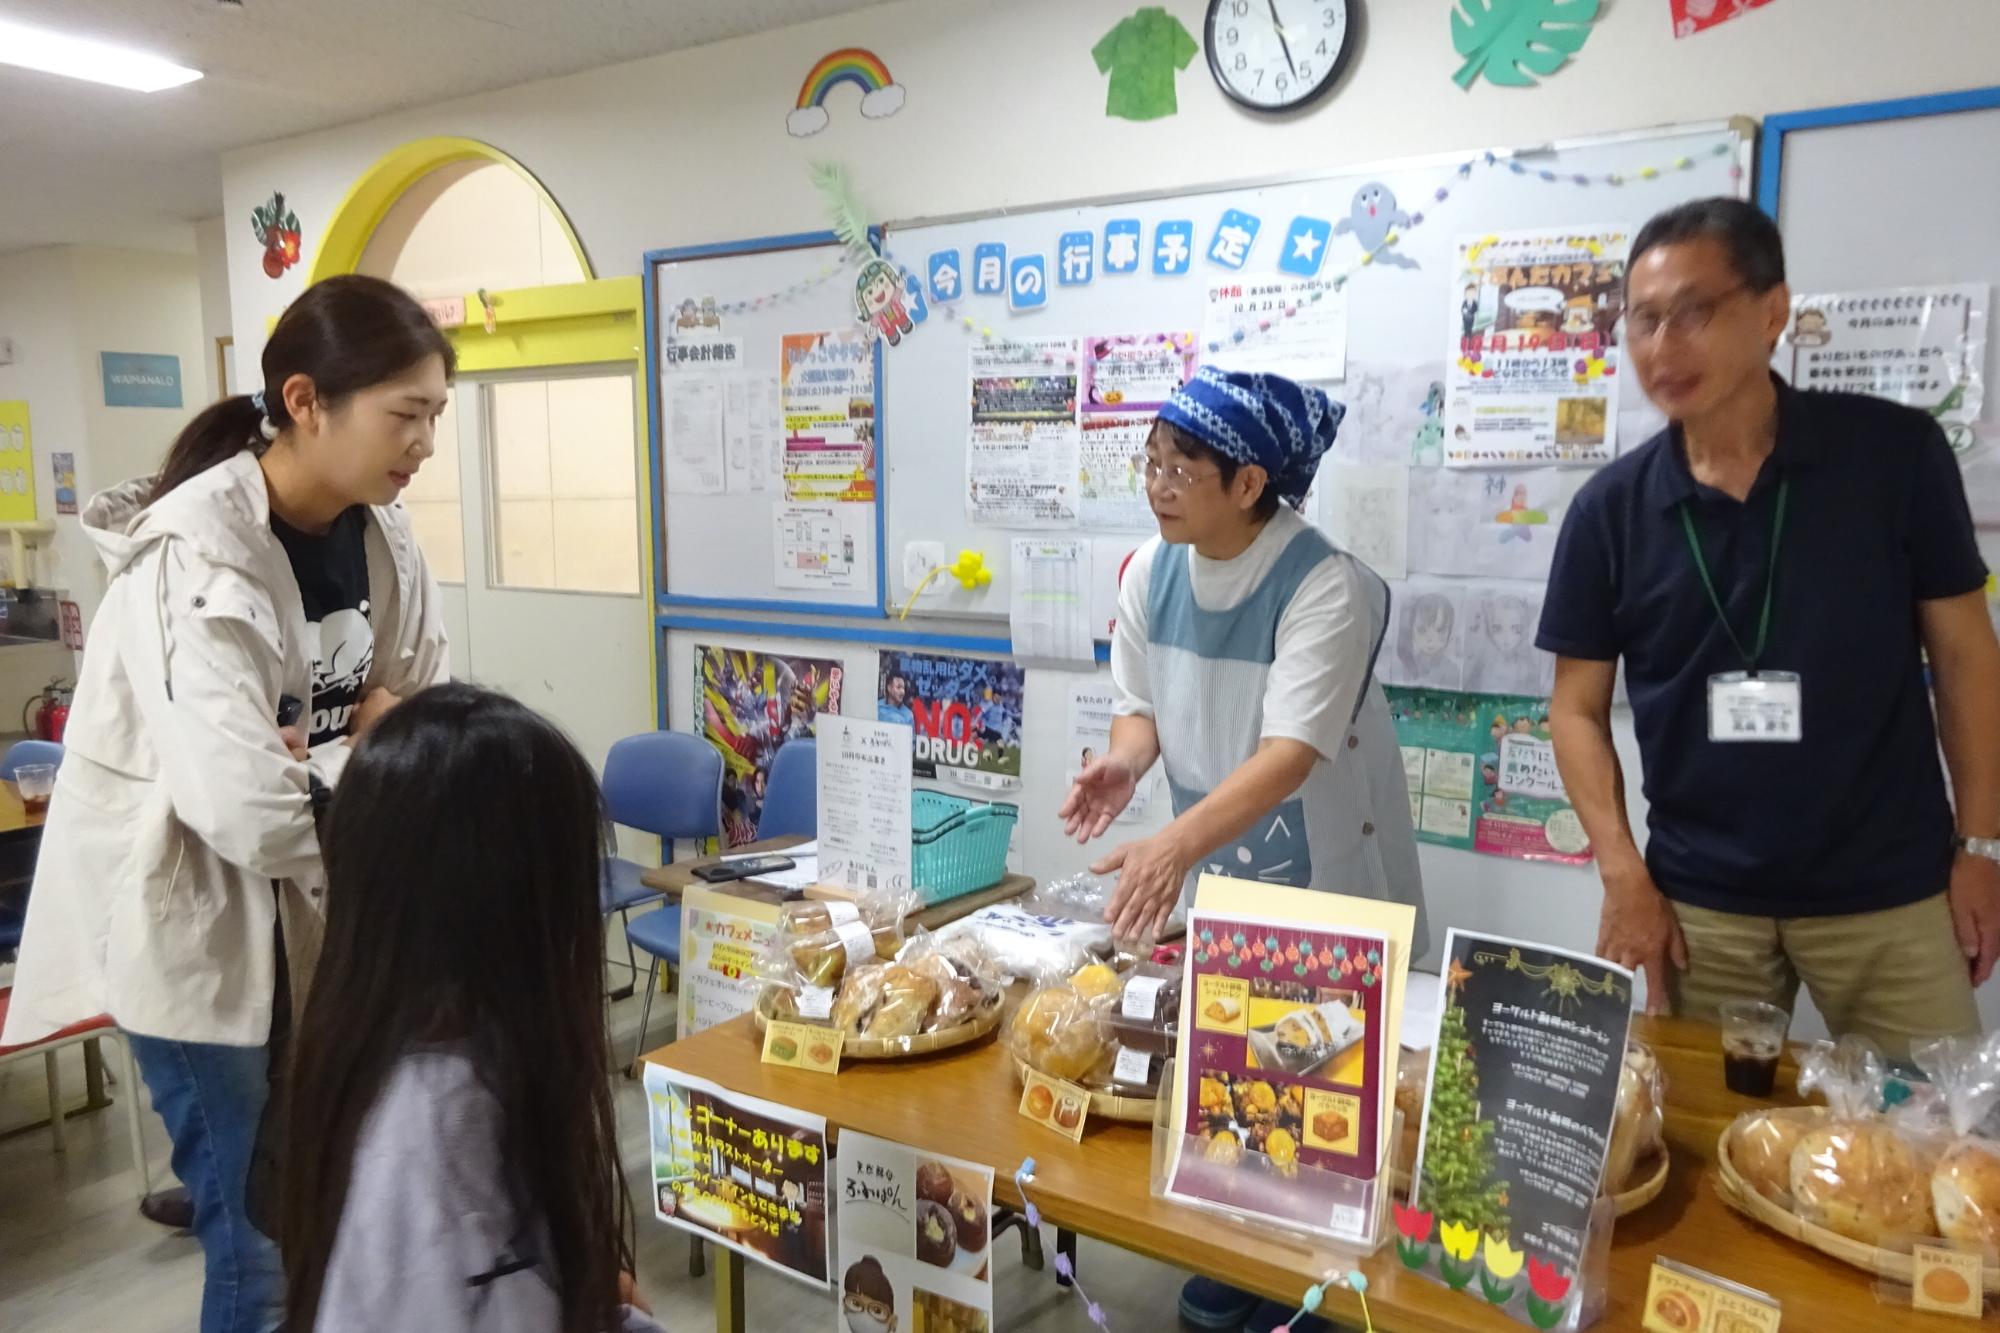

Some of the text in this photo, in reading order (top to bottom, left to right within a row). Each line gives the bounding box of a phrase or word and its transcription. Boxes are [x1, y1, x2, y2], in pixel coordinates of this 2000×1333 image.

[1232, 1, 1248, 18] 10
[1323, 8, 1335, 28] 3
[1226, 27, 1239, 45] 9
[1315, 38, 1327, 57] 4
[1235, 53, 1247, 71] 8
[1299, 61, 1312, 79] 5
[1254, 69, 1265, 88] 7
[1275, 72, 1288, 91] 6
[1220, 285, 1242, 299] 休館
[667, 342, 736, 364] 行事会計報告
[110, 374, 175, 387] WAIMANALO
[916, 735, 979, 768] DRUG
[1504, 773, 1559, 791] コンクール
